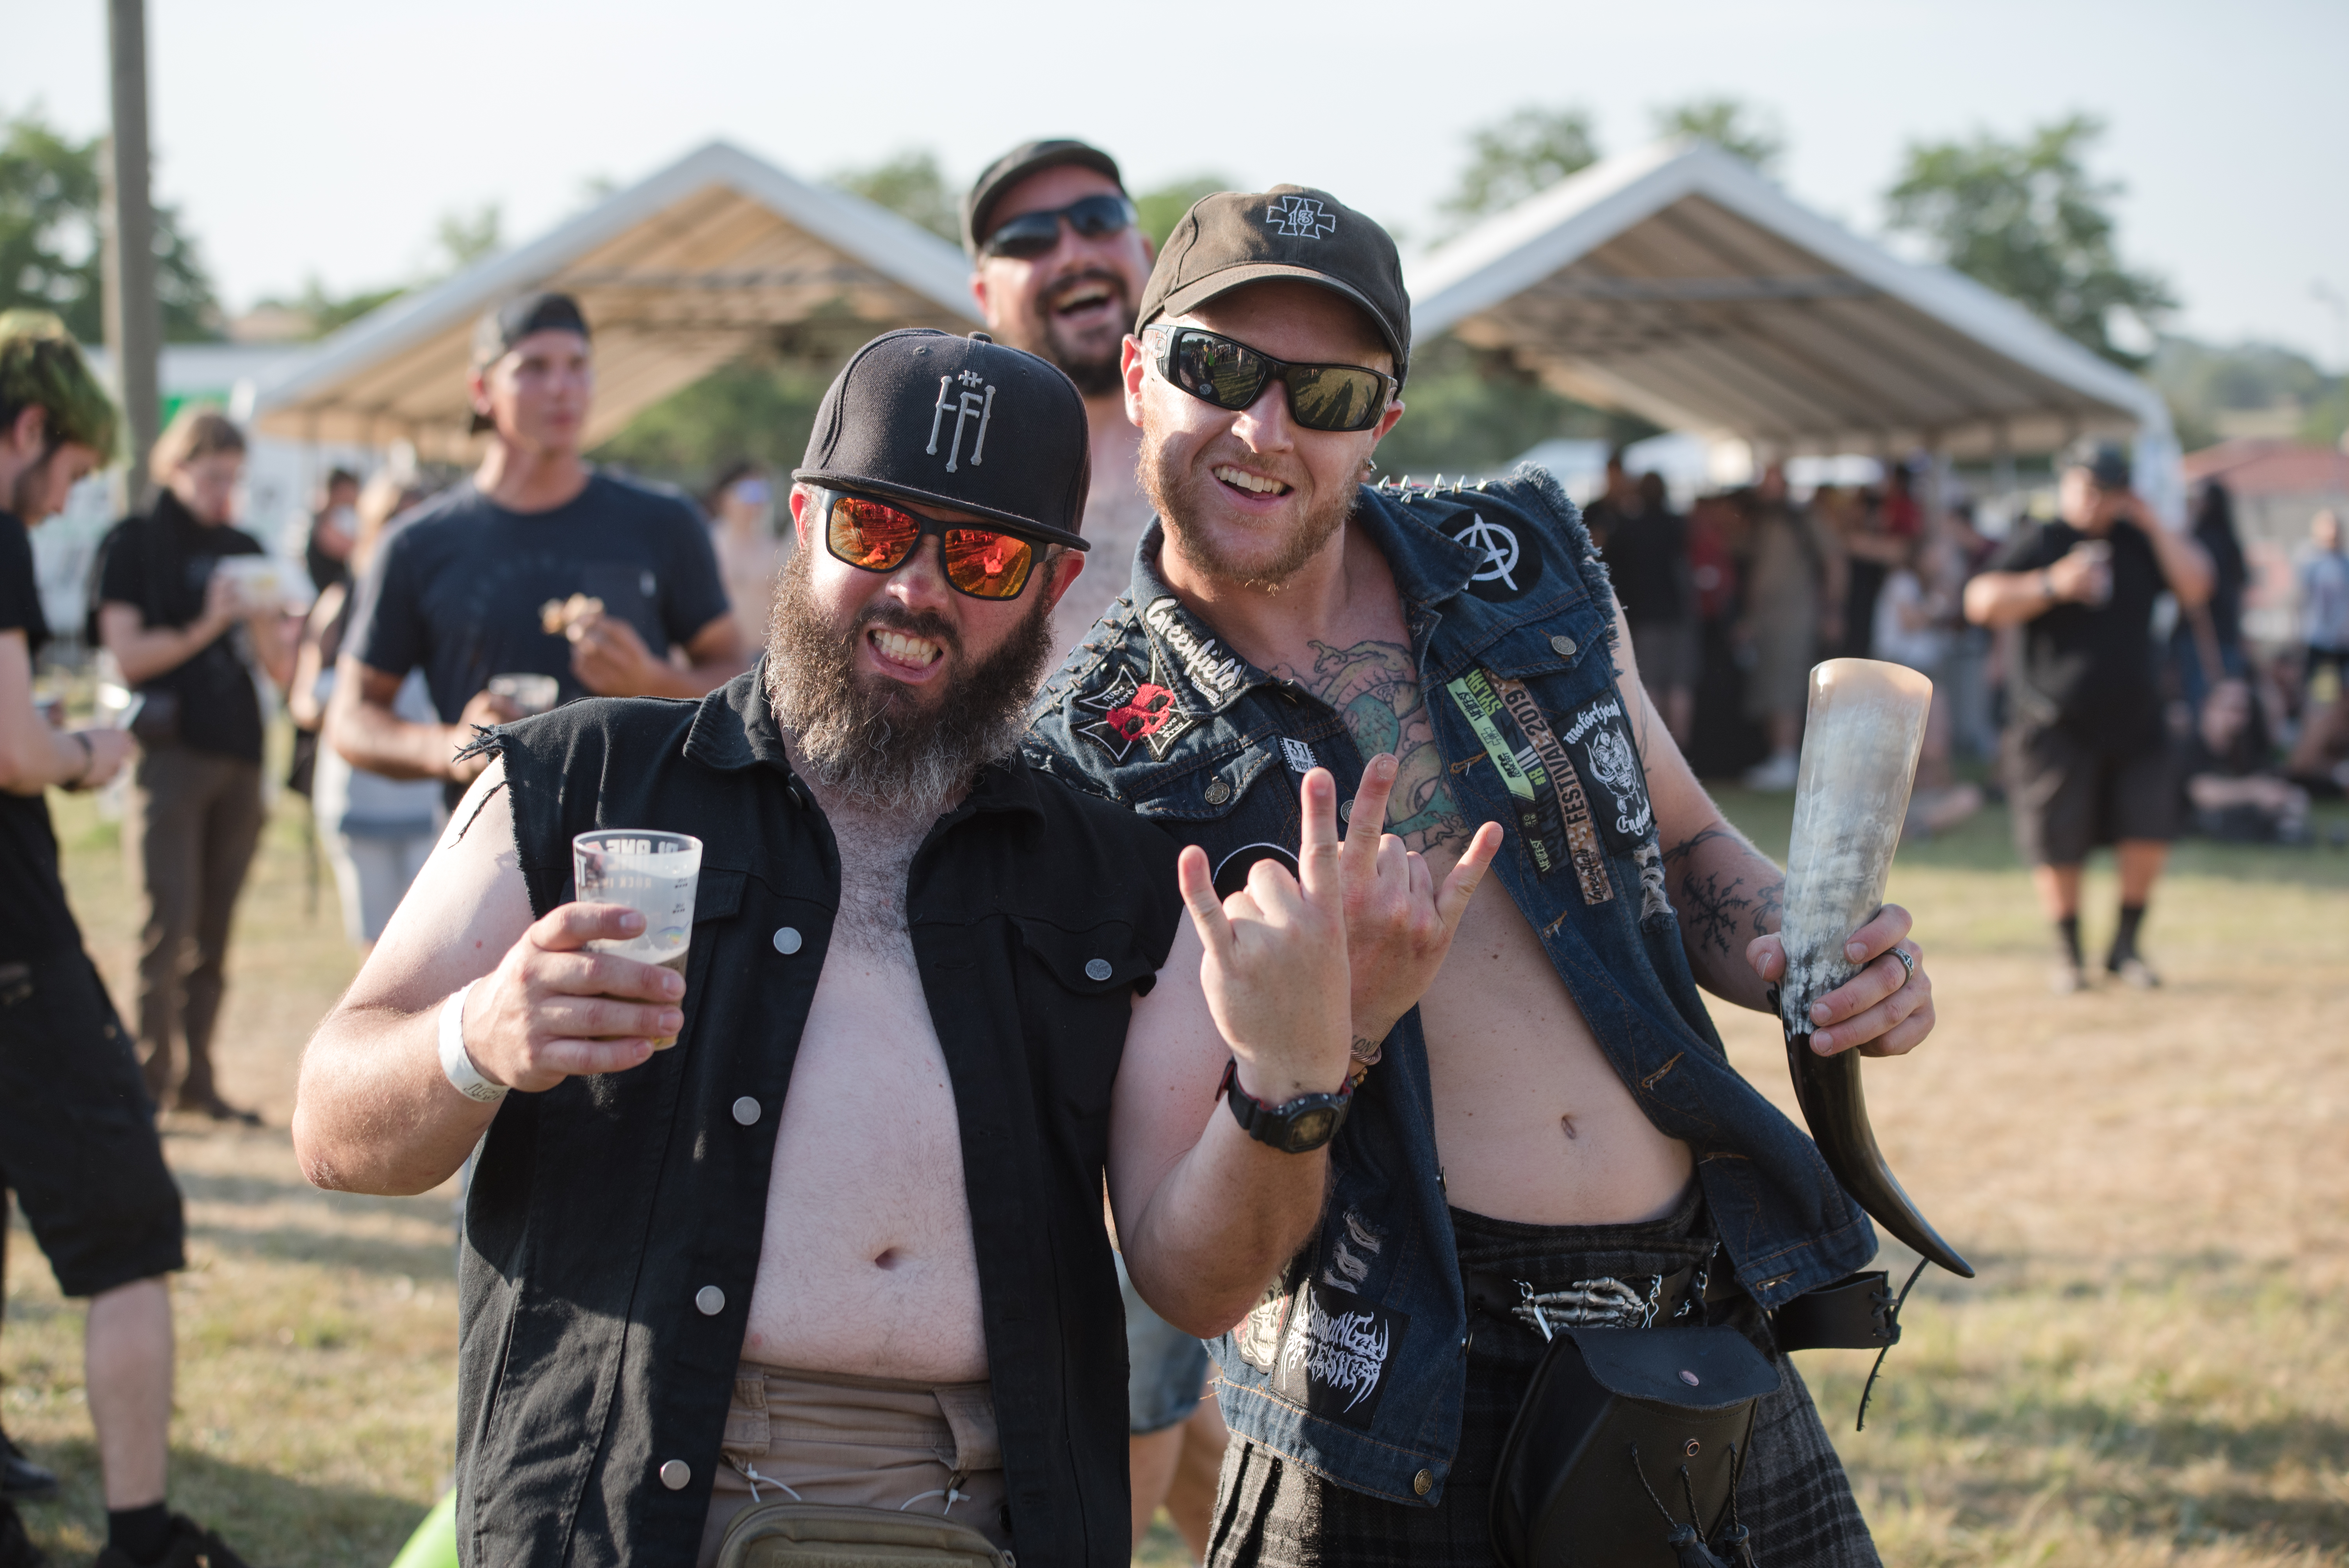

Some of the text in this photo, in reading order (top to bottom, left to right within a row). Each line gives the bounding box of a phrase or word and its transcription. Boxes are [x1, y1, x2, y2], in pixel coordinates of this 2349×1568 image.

[1146, 599, 1243, 692] Greenfield
[1498, 754, 1517, 778] arte
[1502, 752, 1522, 778] CONCERT
[1505, 689, 1588, 825] FESTIVAL 2019
[1527, 766, 1547, 786] #8
